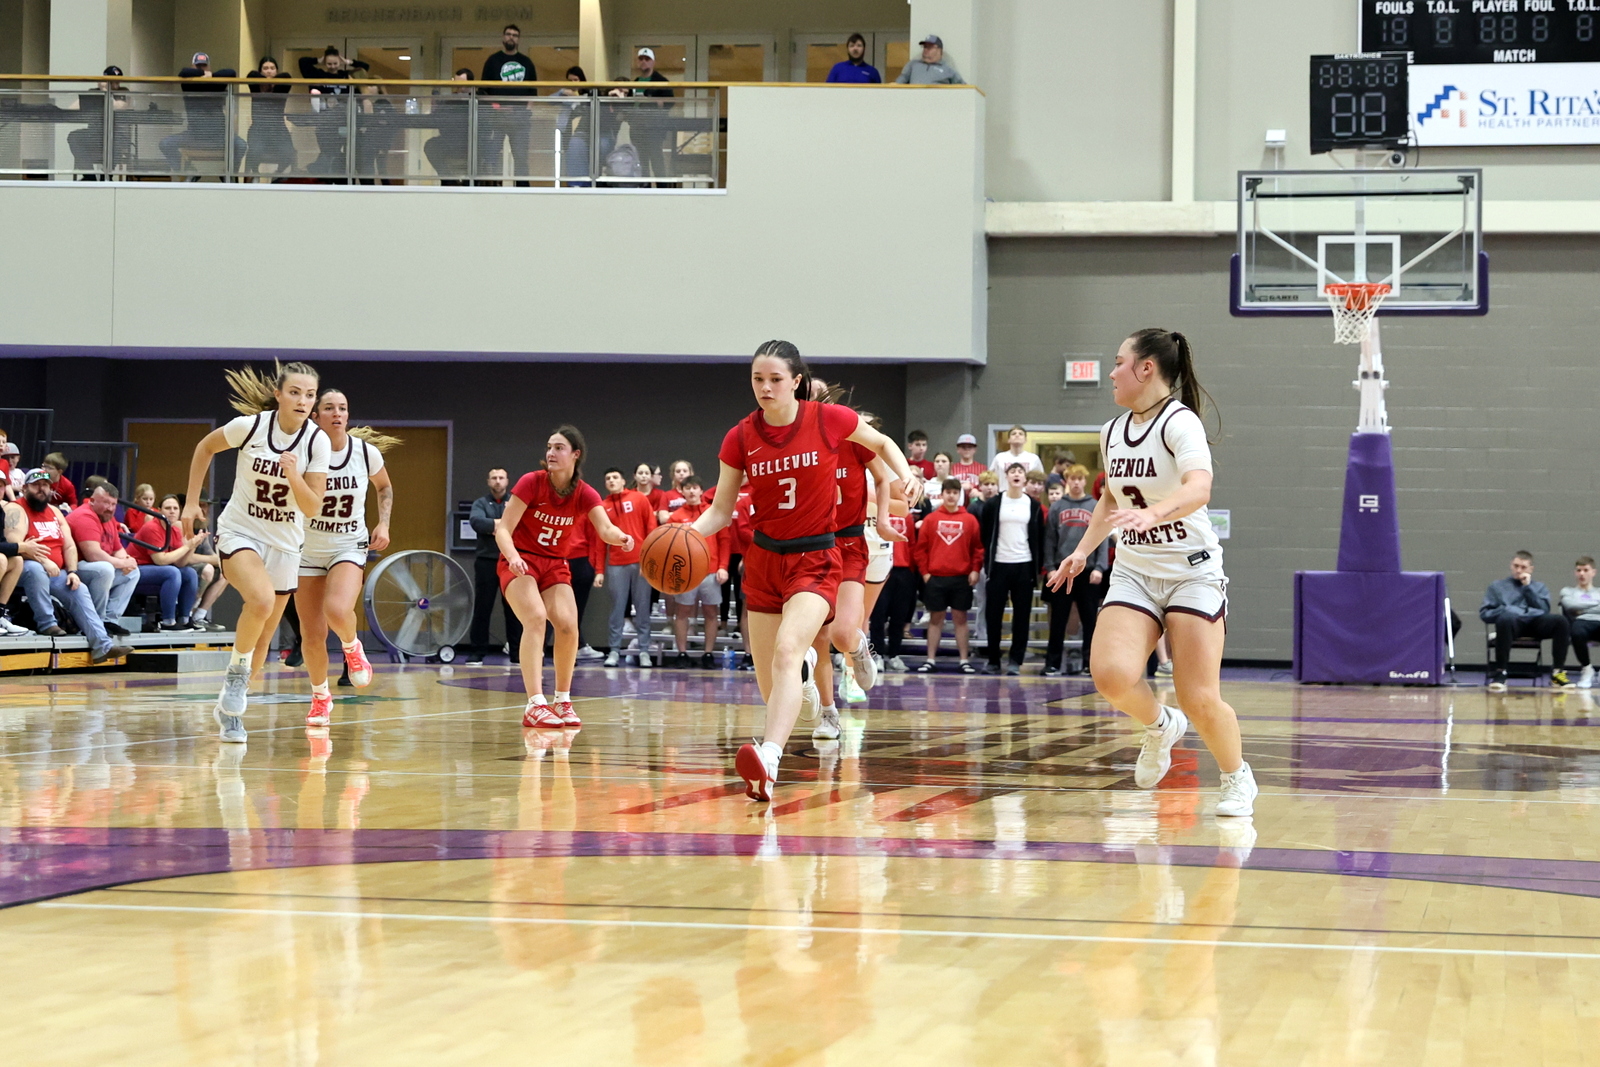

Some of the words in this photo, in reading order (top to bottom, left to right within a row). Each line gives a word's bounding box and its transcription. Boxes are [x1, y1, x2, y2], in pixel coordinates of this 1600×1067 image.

[1375, 1, 1414, 15] FOULS
[1426, 0, 1460, 14] T.O.L.
[1471, 0, 1518, 13] PLAYER
[1524, 0, 1555, 12] FOUL
[1493, 49, 1536, 63] MATCH
[1478, 118, 1531, 128] HEALTH
[1072, 361, 1095, 379] EXIT
[252, 457, 287, 479] GEN
[751, 451, 819, 477] BELLEVUE
[1109, 457, 1157, 478] GENOA
[326, 475, 358, 491] ENOA
[255, 479, 290, 507] 22
[778, 477, 797, 510] 3
[321, 494, 354, 518] 23
[622, 501, 634, 513] B
[309, 518, 358, 533] COMETS
[1121, 520, 1187, 545] COMETS
